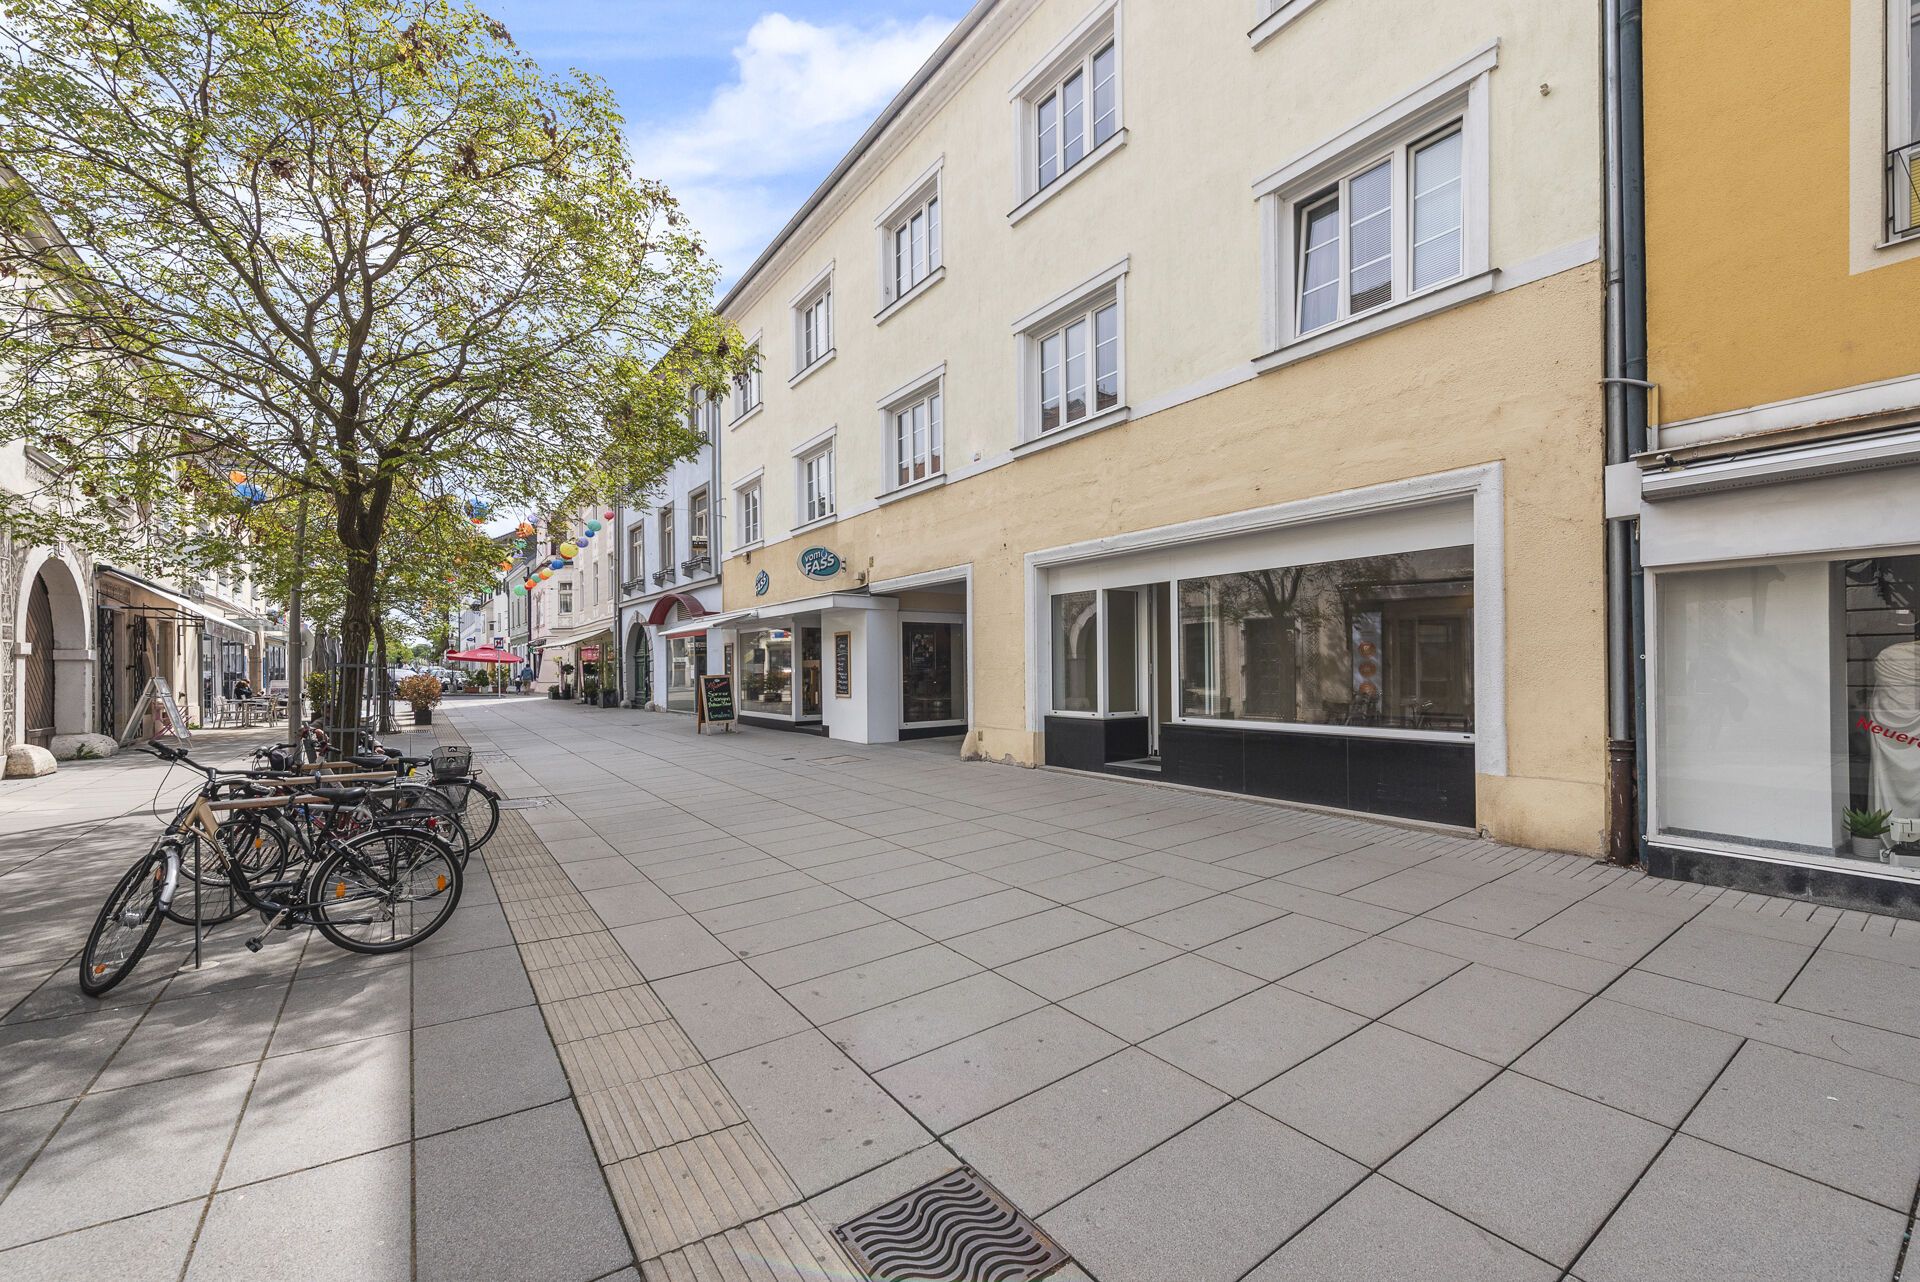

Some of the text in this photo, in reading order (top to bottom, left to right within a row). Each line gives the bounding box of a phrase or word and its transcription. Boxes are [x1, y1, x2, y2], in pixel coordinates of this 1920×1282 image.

[804, 550, 821, 562] vom
[804, 553, 835, 576] FASS
[1856, 717, 1920, 749] Neuer
